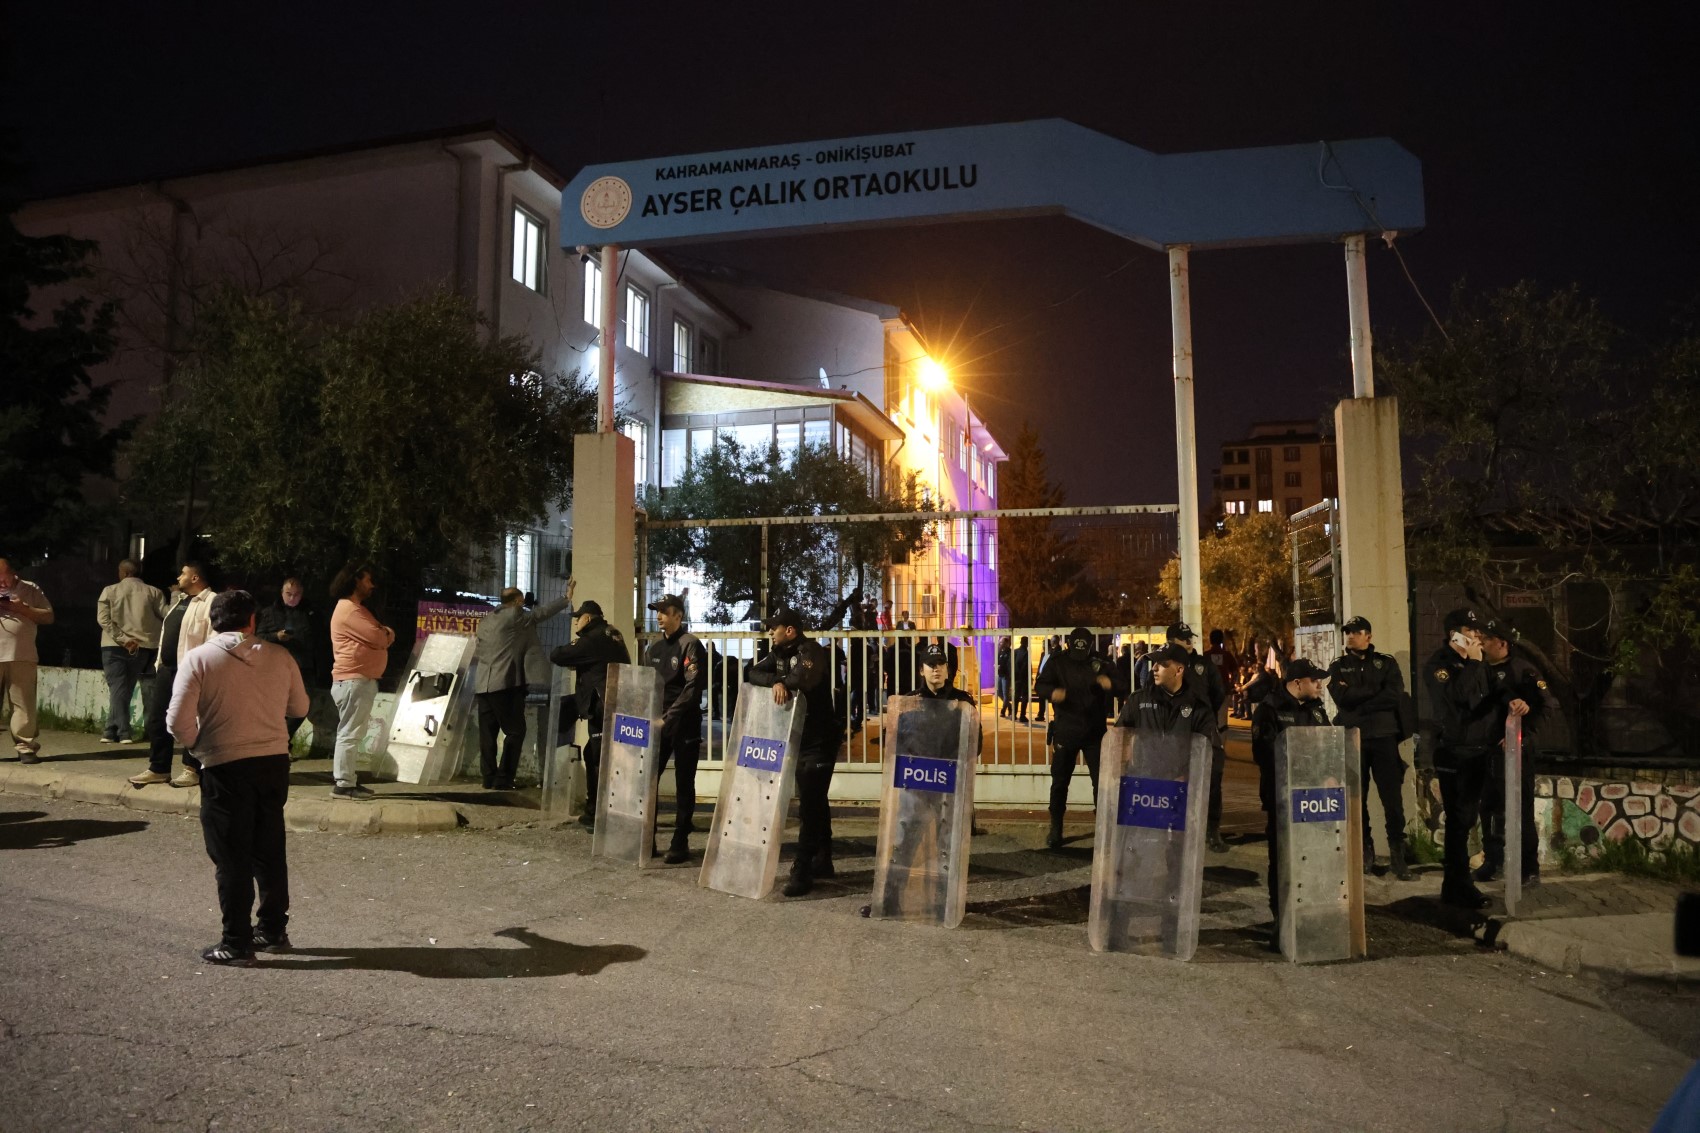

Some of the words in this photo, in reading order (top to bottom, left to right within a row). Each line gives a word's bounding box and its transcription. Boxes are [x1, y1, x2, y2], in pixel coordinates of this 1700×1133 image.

[655, 153, 800, 181] KAHRAMANMARAŞ
[815, 142, 915, 165] ONİKİŞUBAT
[641, 187, 722, 217] AYSER
[729, 179, 807, 215] ÇALIK
[813, 164, 978, 200] ORTAOKULU
[423, 616, 459, 631] ANA
[620, 725, 644, 739] POLİS
[745, 746, 778, 762] POLİS
[903, 767, 947, 784] POLİS
[1300, 798, 1339, 814] POLİS
